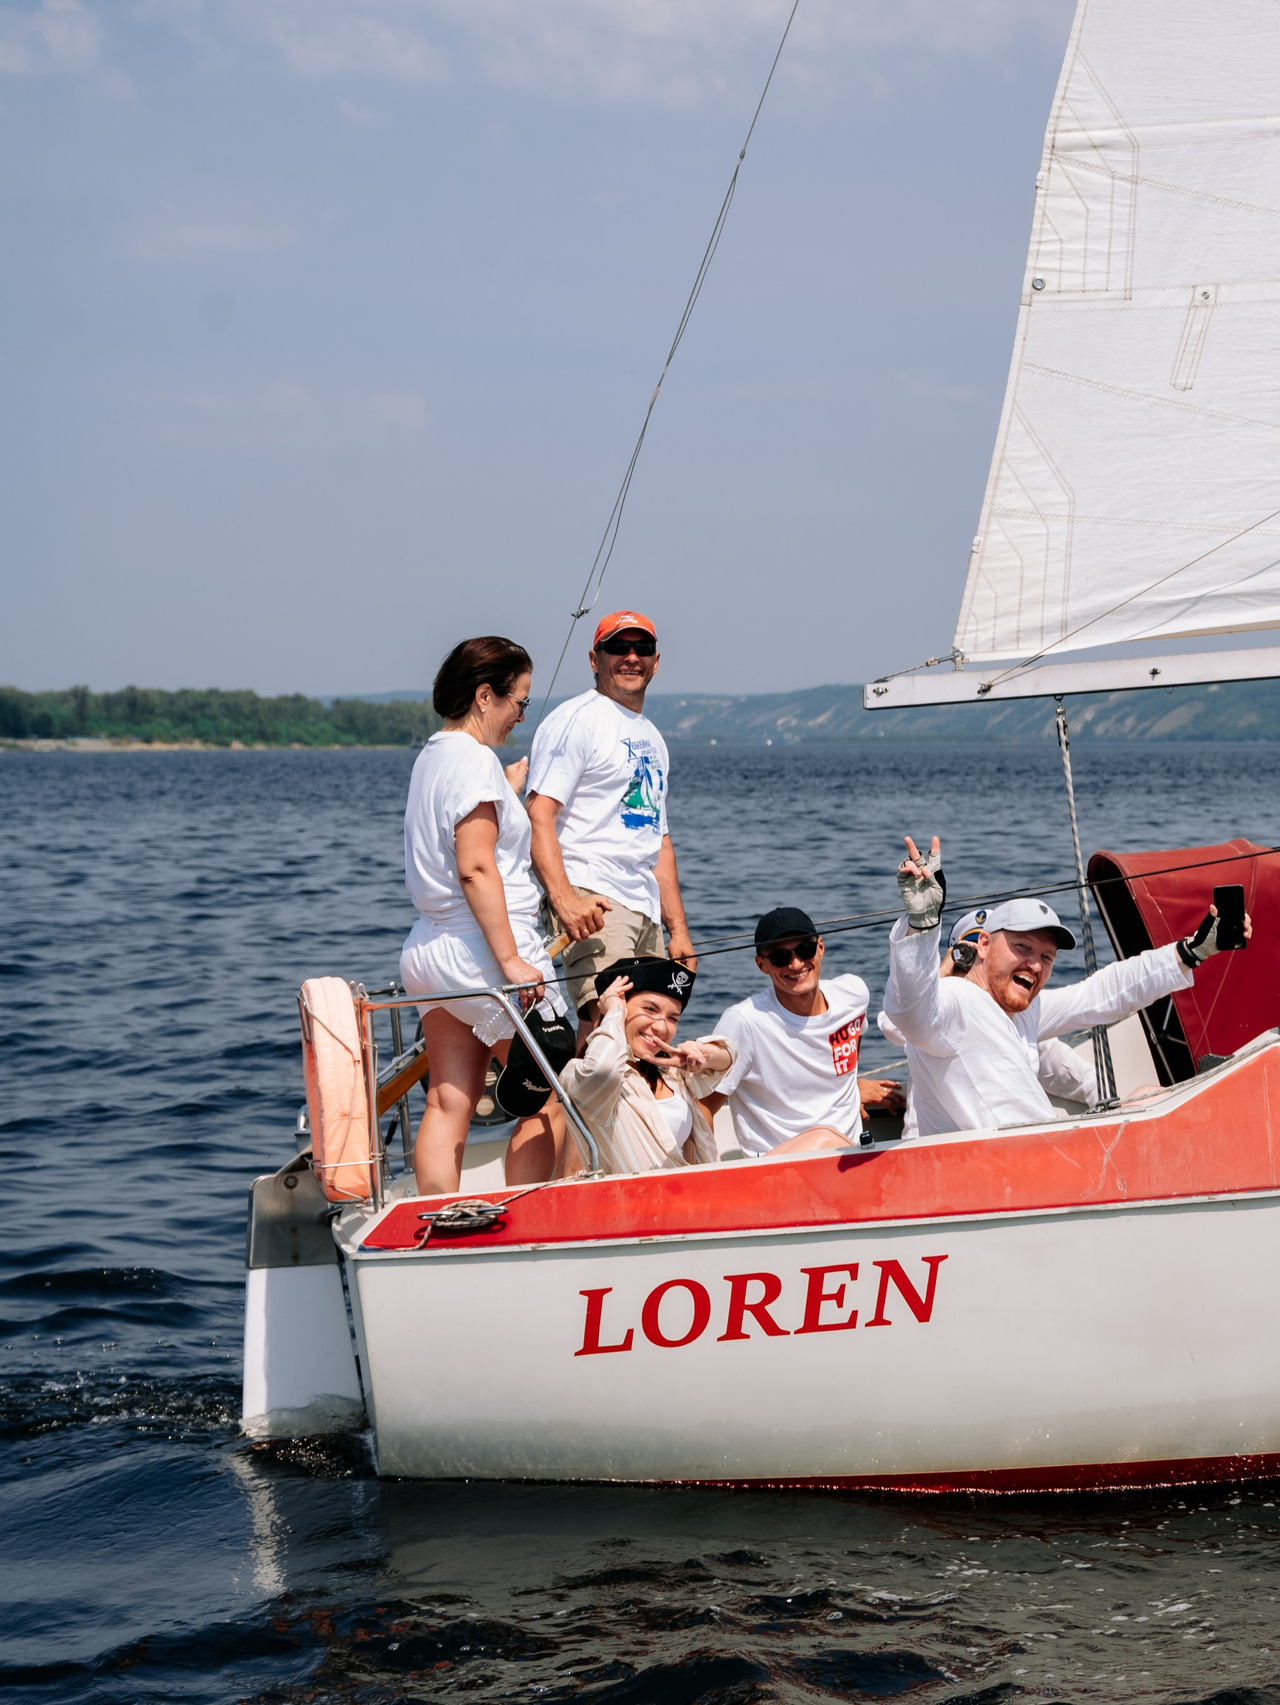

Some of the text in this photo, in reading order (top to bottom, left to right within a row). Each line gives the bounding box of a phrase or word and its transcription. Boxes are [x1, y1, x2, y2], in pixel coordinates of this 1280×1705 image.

[829, 1018, 861, 1046] HUGO
[834, 1038, 858, 1061] FOR
[835, 1058, 849, 1075] IT
[574, 1254, 949, 1357] LOREN
